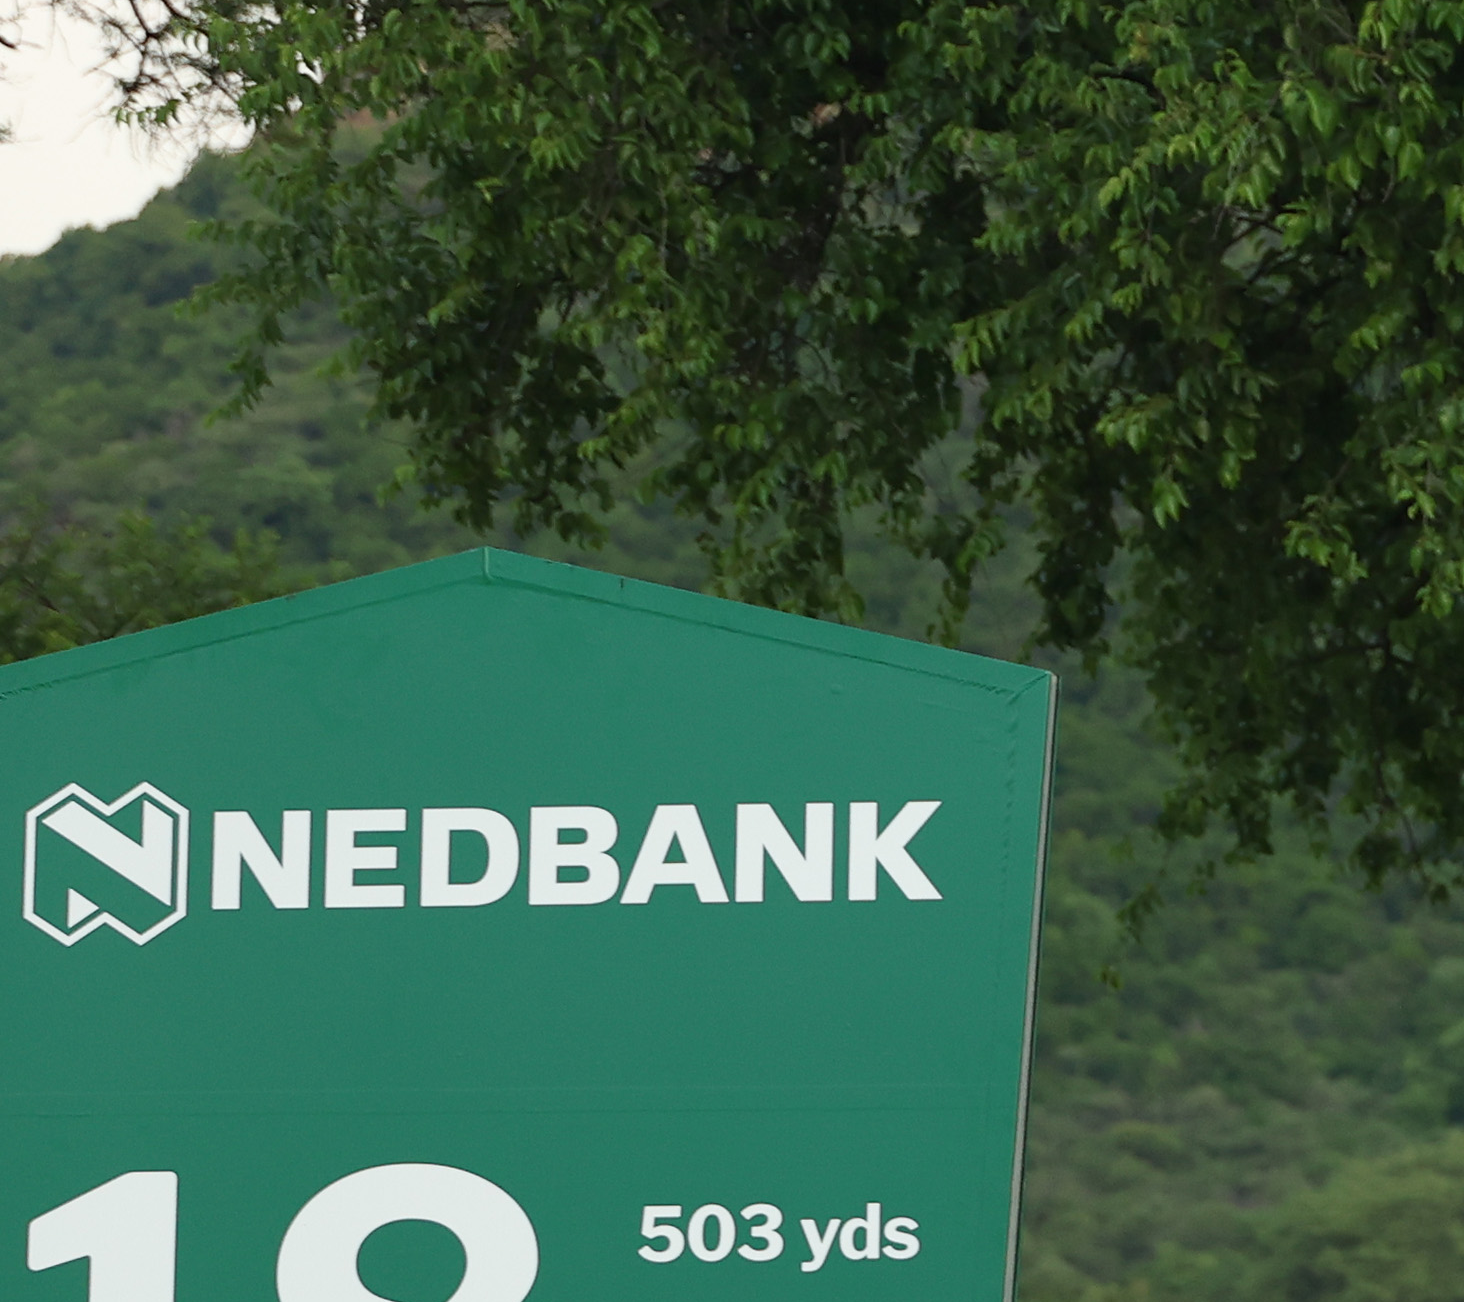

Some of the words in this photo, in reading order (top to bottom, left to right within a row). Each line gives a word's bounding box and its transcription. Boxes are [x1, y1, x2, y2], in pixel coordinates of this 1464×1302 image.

[212, 801, 942, 909] NEDBANK
[638, 1204, 783, 1262] 503
[800, 1203, 919, 1273] yds
